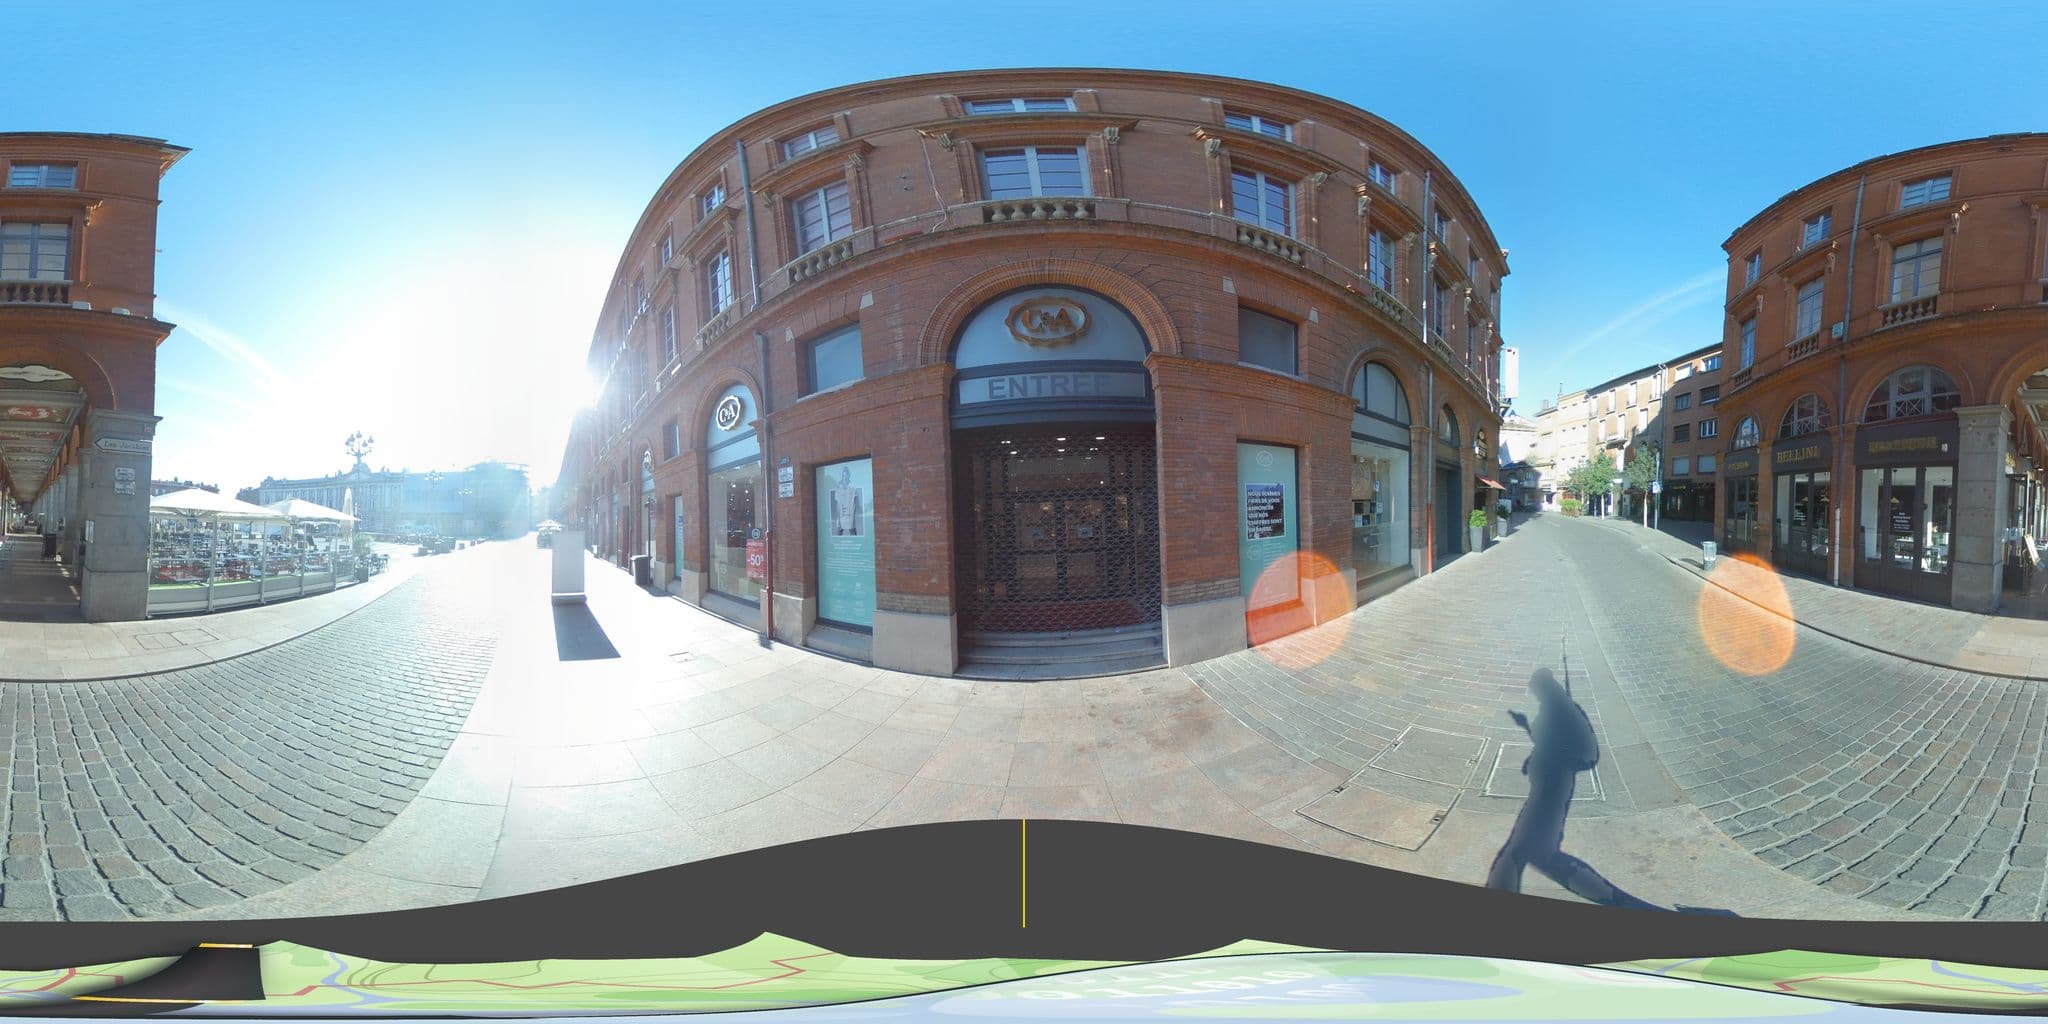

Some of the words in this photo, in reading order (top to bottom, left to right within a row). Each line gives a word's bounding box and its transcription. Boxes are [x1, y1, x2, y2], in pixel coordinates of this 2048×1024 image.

[1021, 307, 1074, 334] C&A
[719, 404, 736, 423] C&A
[1776, 446, 1820, 463] BELLINI
